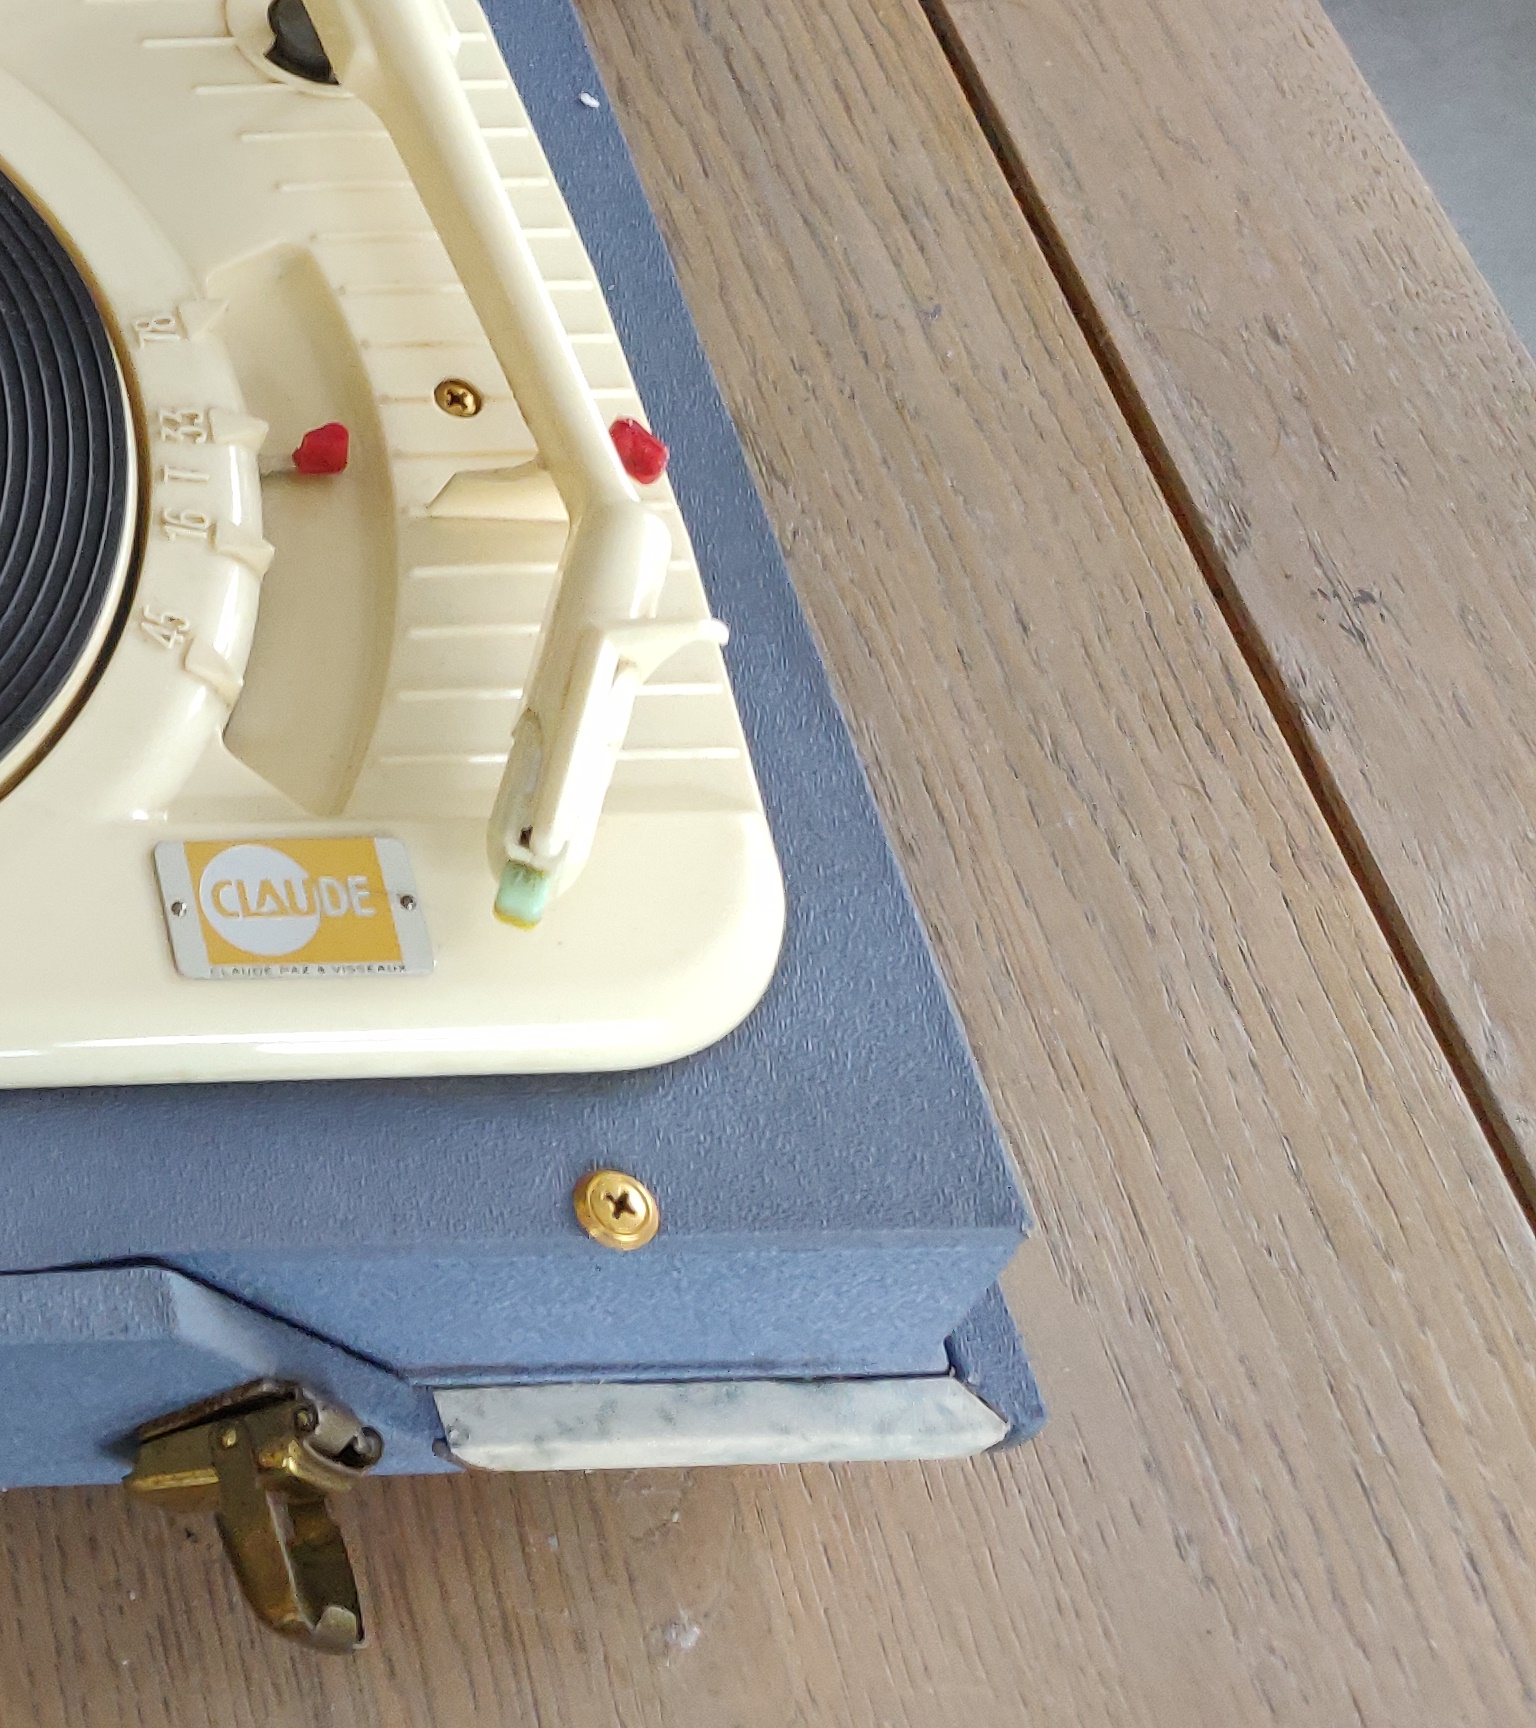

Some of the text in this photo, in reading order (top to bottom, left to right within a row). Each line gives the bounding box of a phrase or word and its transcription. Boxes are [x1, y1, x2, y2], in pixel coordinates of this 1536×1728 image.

[134, 316, 181, 348] 78
[160, 411, 207, 444] 33
[162, 508, 212, 540] 16
[140, 604, 191, 650] 45
[210, 875, 378, 918] CLAUDE
